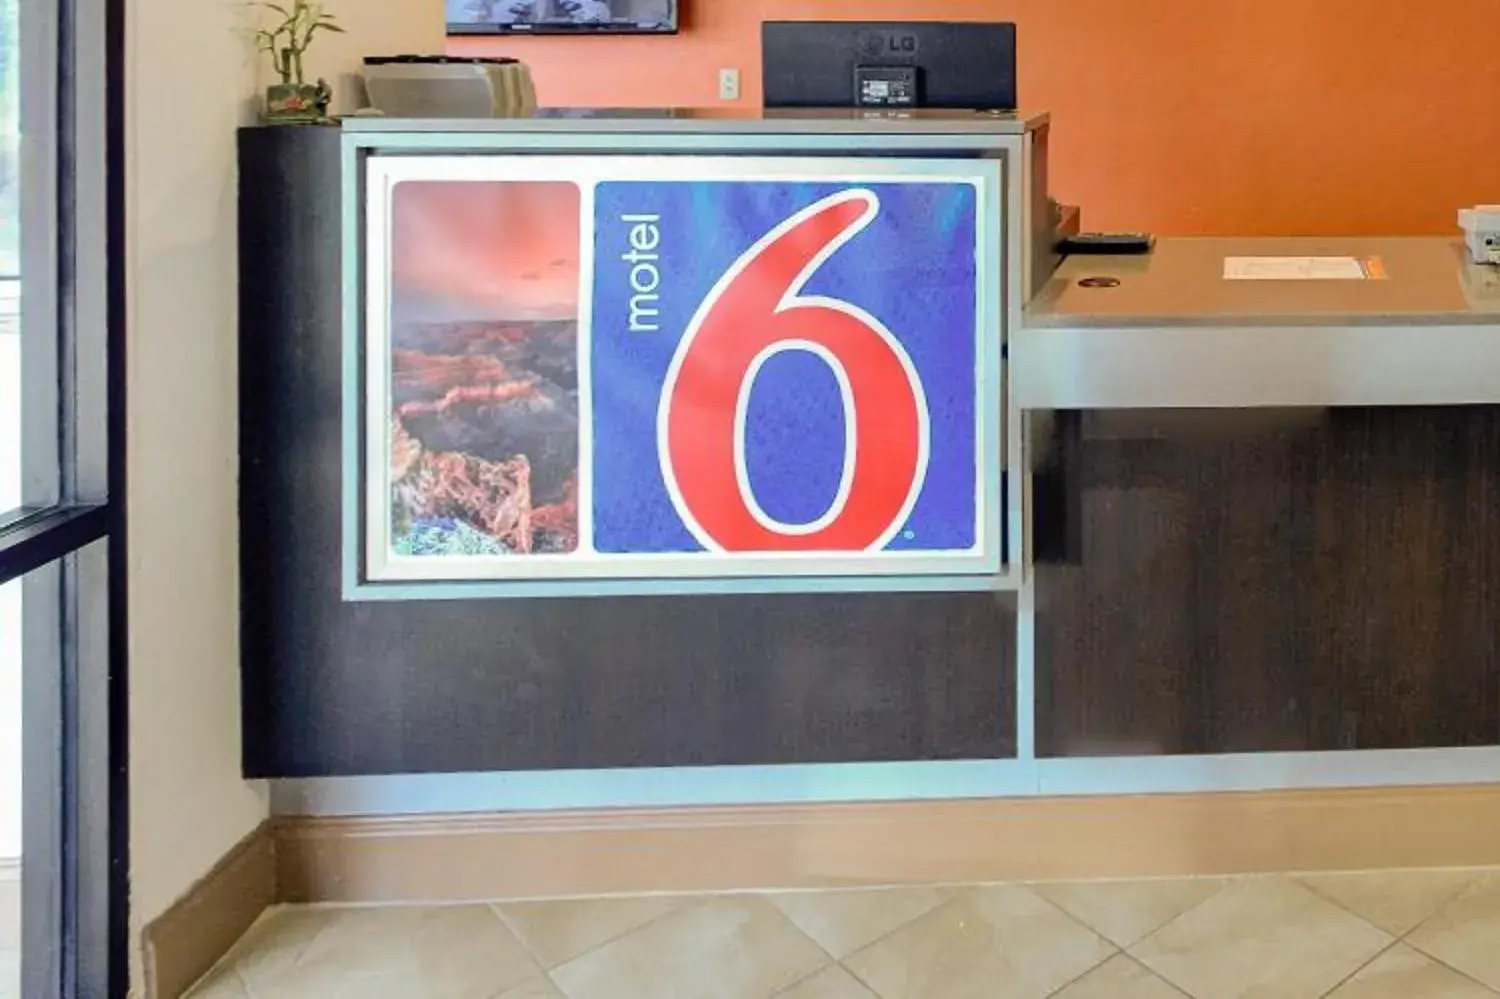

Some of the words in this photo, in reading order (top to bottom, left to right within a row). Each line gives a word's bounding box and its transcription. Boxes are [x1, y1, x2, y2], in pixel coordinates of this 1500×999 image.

[889, 35, 915, 51] LG
[622, 213, 660, 332] motel
[656, 188, 931, 553] 6
